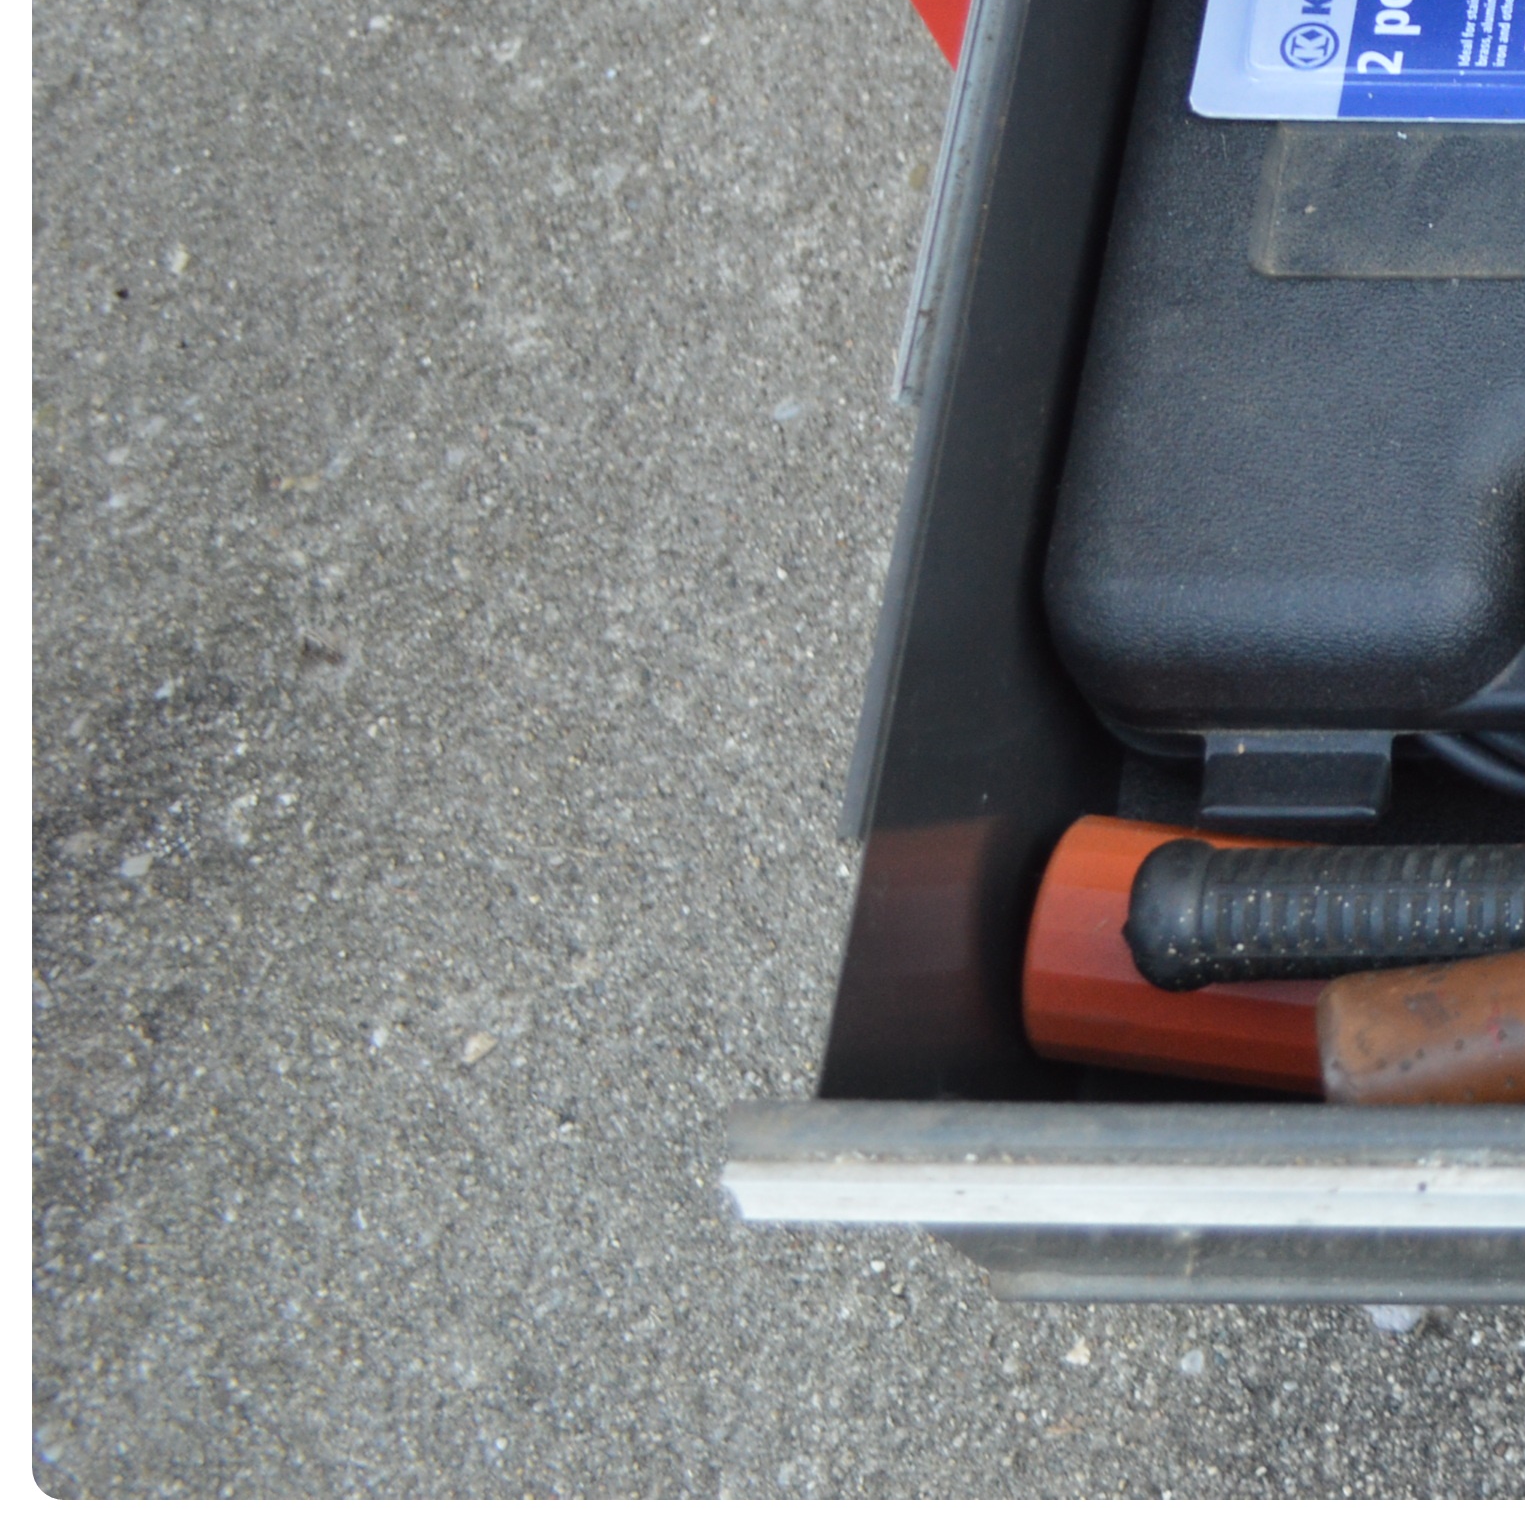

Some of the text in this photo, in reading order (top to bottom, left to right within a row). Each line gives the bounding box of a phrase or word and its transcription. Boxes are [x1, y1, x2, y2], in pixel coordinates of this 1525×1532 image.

[1462, 21, 1475, 38] for
[1499, 23, 1510, 43] and
[1458, 39, 1473, 66] Ideal
[1475, 35, 1492, 67] brass,
[1493, 45, 1507, 67] iron
[1357, 51, 1403, 74] 2
